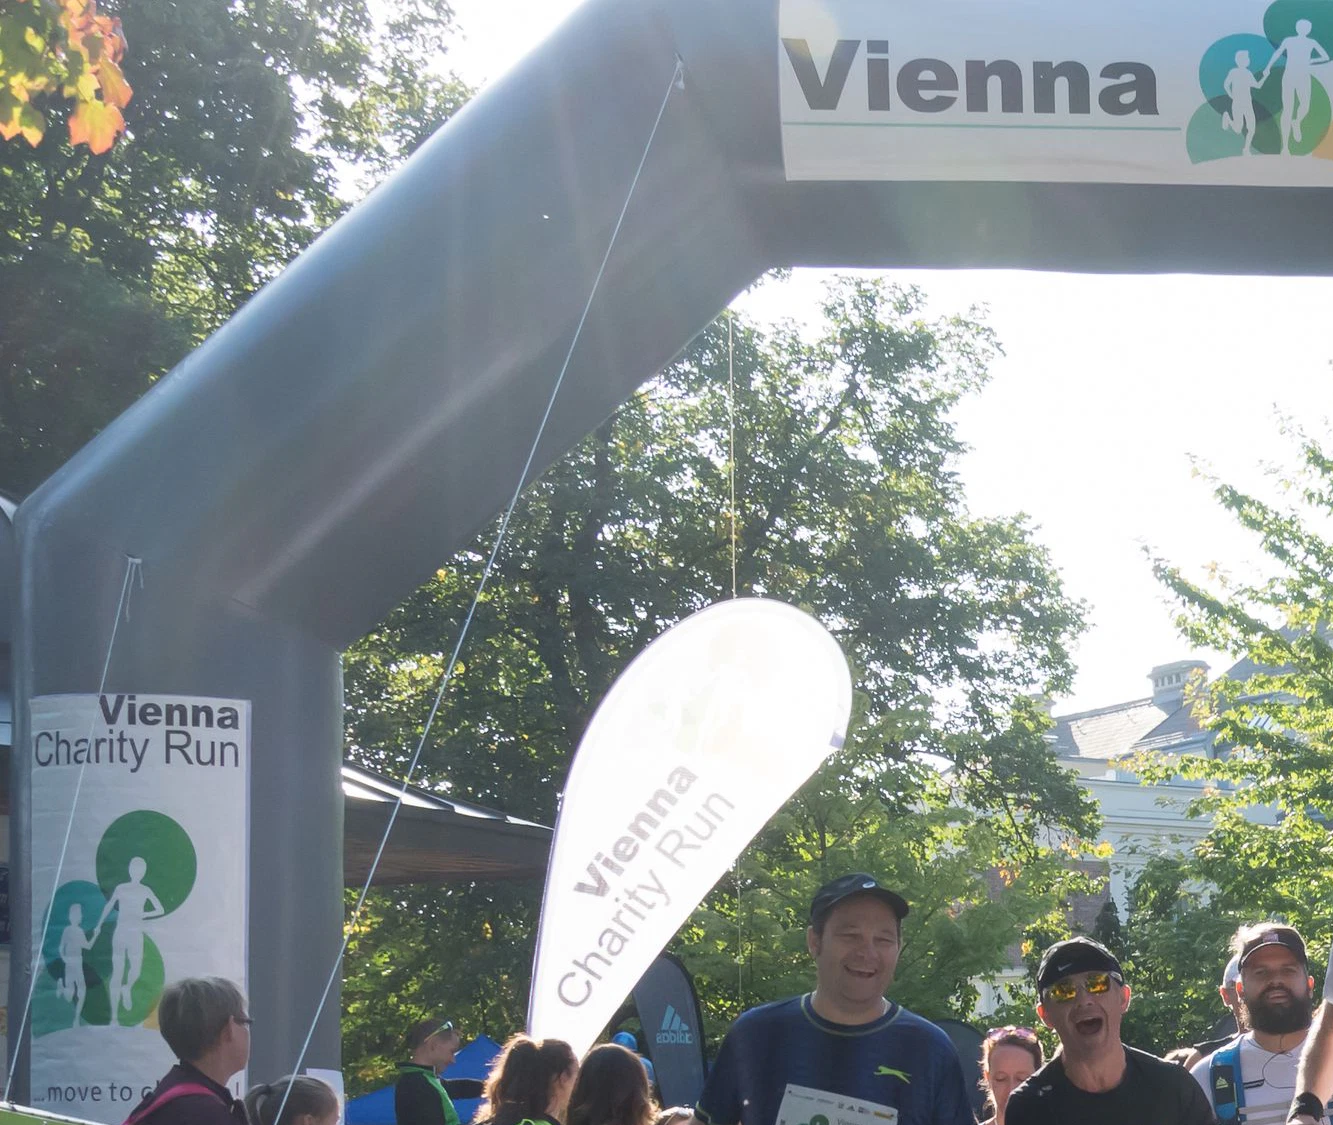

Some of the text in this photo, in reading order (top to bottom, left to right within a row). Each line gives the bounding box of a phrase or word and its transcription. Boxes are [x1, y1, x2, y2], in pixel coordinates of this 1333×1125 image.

[781, 38, 1159, 116] Vienna
[99, 695, 240, 730] Vienna
[35, 729, 239, 773] Charity Run
[573, 766, 699, 897] Vienna
[557, 792, 736, 1008] Charity Run
[110, 1081, 134, 1102] to
